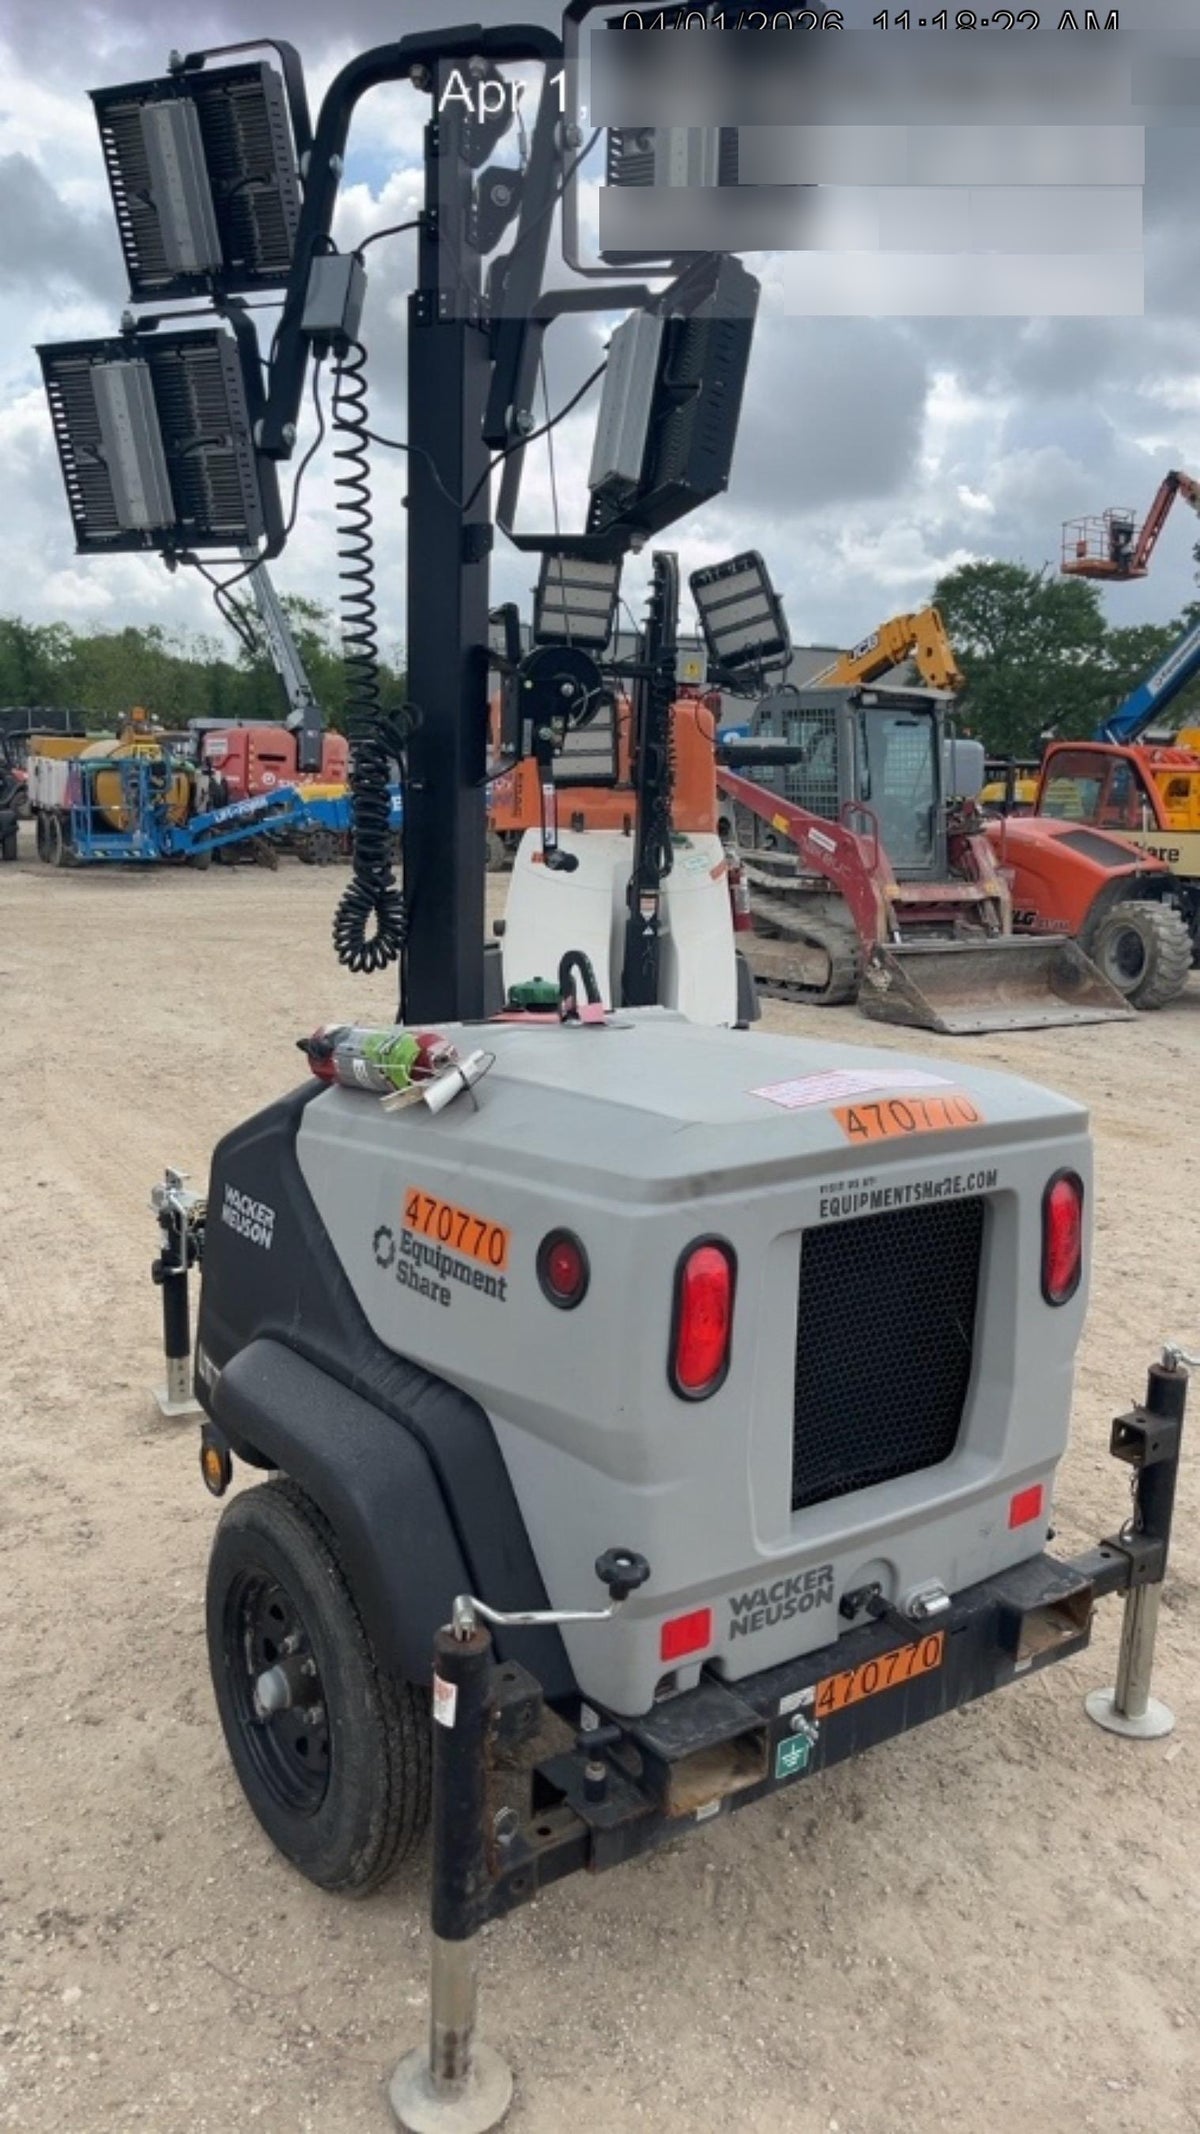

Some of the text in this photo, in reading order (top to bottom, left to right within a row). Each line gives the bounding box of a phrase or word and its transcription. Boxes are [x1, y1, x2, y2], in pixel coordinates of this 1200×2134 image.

[1011, 909, 1037, 926] LG
[847, 1095, 979, 1139] 470770
[222, 1203, 273, 1251] NEUSON
[224, 1182, 276, 1230] WACKER
[405, 1193, 506, 1267] 470770
[396, 1258, 452, 1308] Share
[400, 1227, 508, 1303] Equipment
[728, 1563, 835, 1617] WACKER
[728, 1583, 835, 1641] NEUSON
[817, 1634, 941, 1711] 470770
